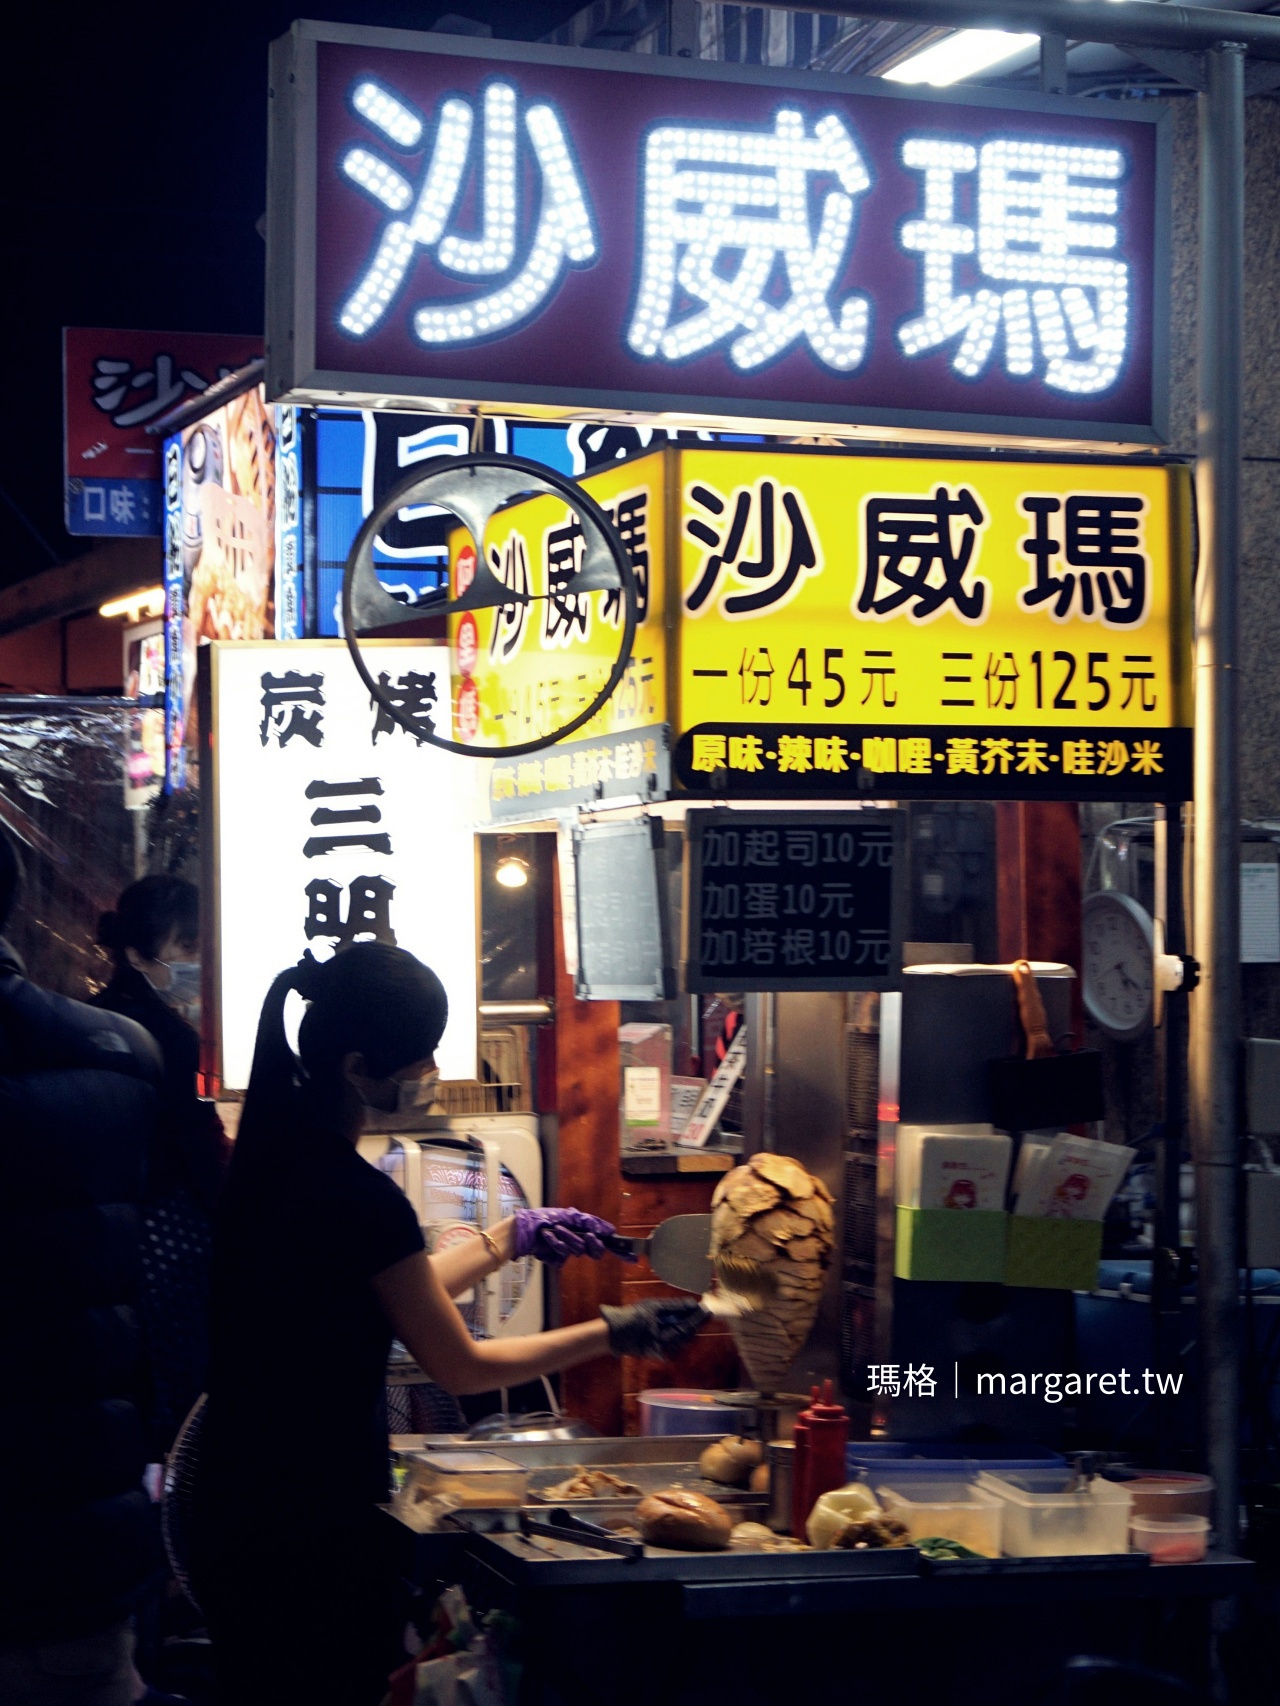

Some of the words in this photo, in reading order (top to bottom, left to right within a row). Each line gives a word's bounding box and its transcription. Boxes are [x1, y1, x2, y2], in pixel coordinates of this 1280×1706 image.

[338, 81, 1131, 395] 沙威瑪
[686, 481, 1146, 625] 沙威瑪
[692, 646, 899, 709] 一份45元
[941, 650, 1158, 713] 三份125元
[302, 777, 398, 958] 三明
[703, 828, 894, 867] 加起司10元
[703, 881, 855, 919] 加蛋10元
[701, 927, 891, 966] 加培根10元
